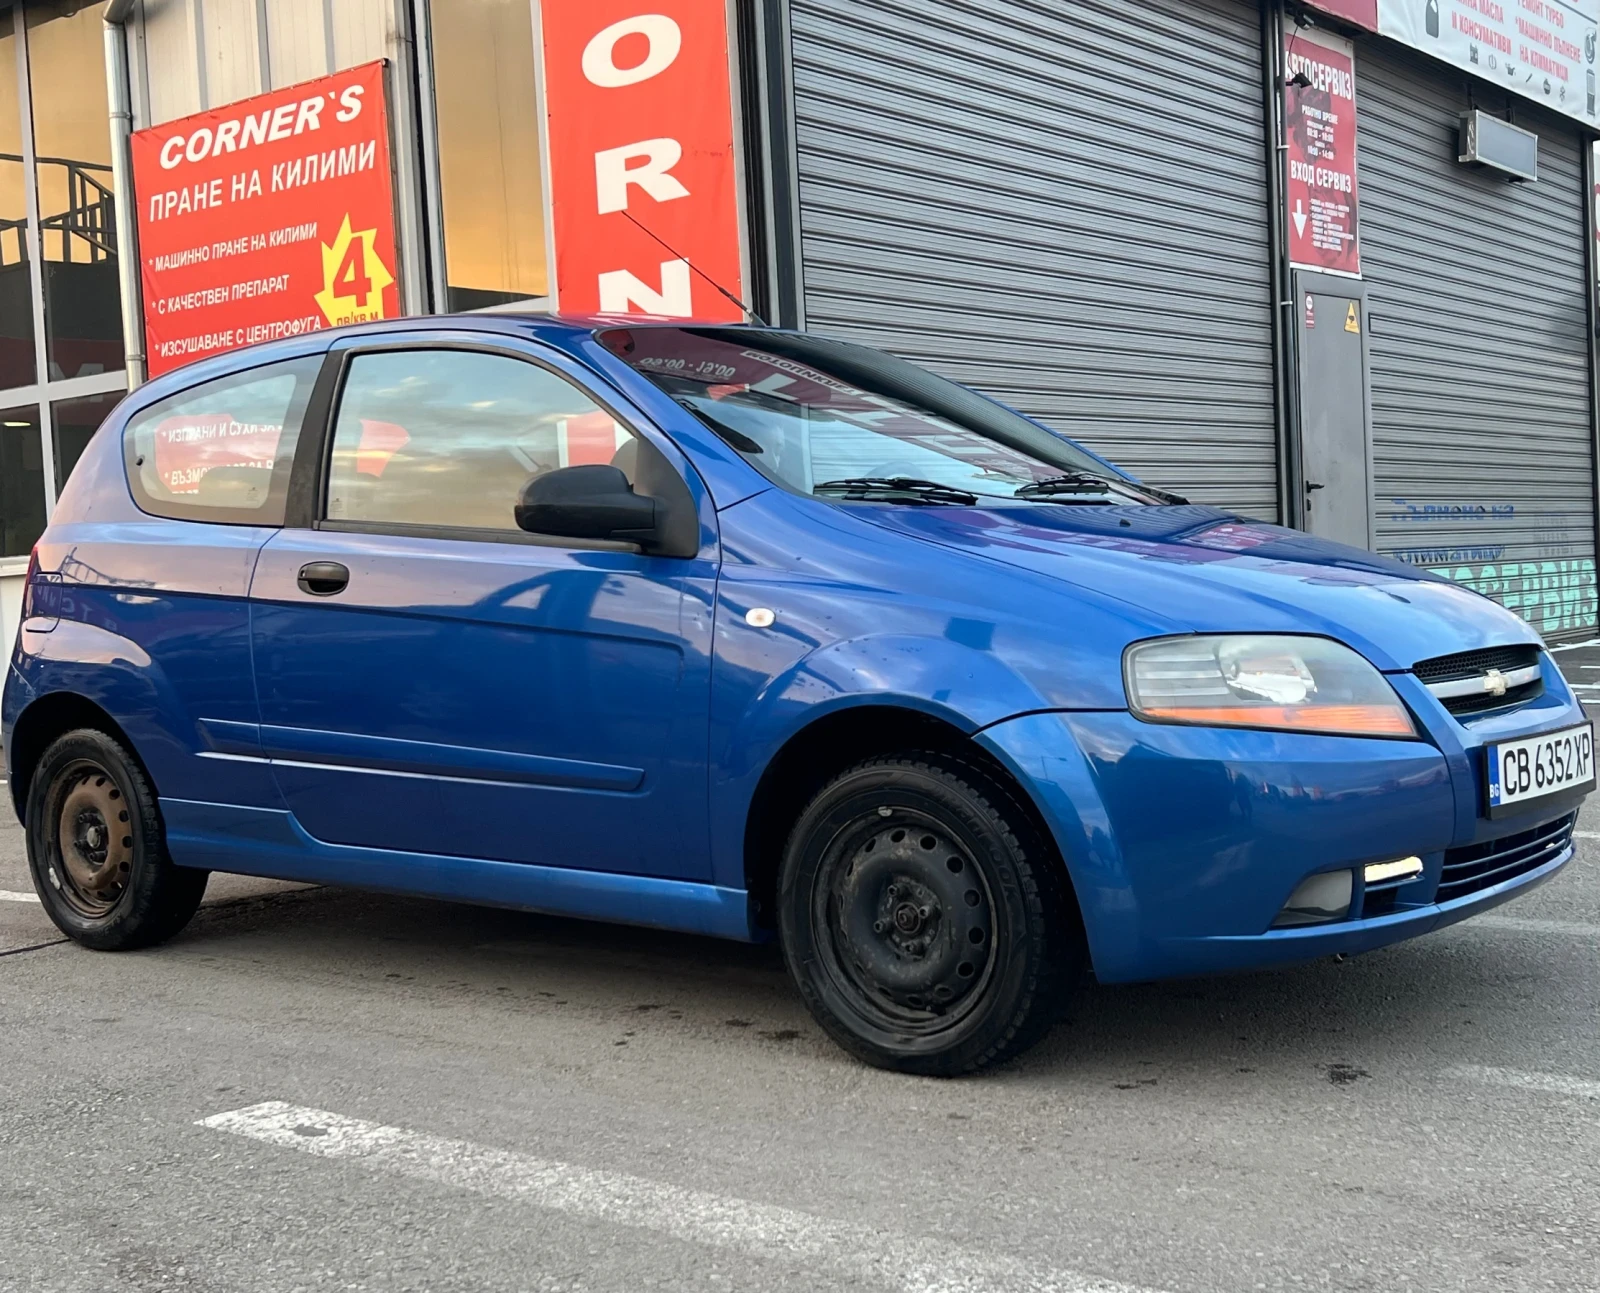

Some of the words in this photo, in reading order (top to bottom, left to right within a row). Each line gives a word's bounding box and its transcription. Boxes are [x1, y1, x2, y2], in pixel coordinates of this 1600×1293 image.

[1459, 14, 1511, 55] КОНСУМАТИВИ
[1520, 44, 1529, 64] НА
[1285, 51, 1352, 100] АВТОСЕРВИЗ
[149, 179, 223, 222] ПРАНЕ
[231, 169, 262, 202] НА
[271, 140, 376, 192] КИЛИМИ
[1291, 160, 1315, 187] ВХОД
[1316, 167, 1352, 193] СЕРВИЗ
[155, 246, 210, 272] МАШИННО
[212, 237, 248, 259] ПРАНЕ
[251, 233, 267, 251] НА
[269, 222, 318, 247] КИЛИМИ
[333, 235, 372, 308] 4
[158, 299, 166, 314] С
[167, 286, 229, 313] КАЧЕСТВЕН
[231, 274, 289, 300] ПРЕПАРАТ
[161, 330, 233, 357] ИЗСУШАВАНЕ
[236, 329, 244, 344] С
[246, 315, 321, 344] ЦЕНТРОФУГА
[168, 424, 216, 442] ИЗПРАНИ
[219, 422, 227, 437] И
[1504, 748, 1531, 795] CB
[1535, 737, 1573, 789] 6352
[1489, 783, 1499, 798] BG
